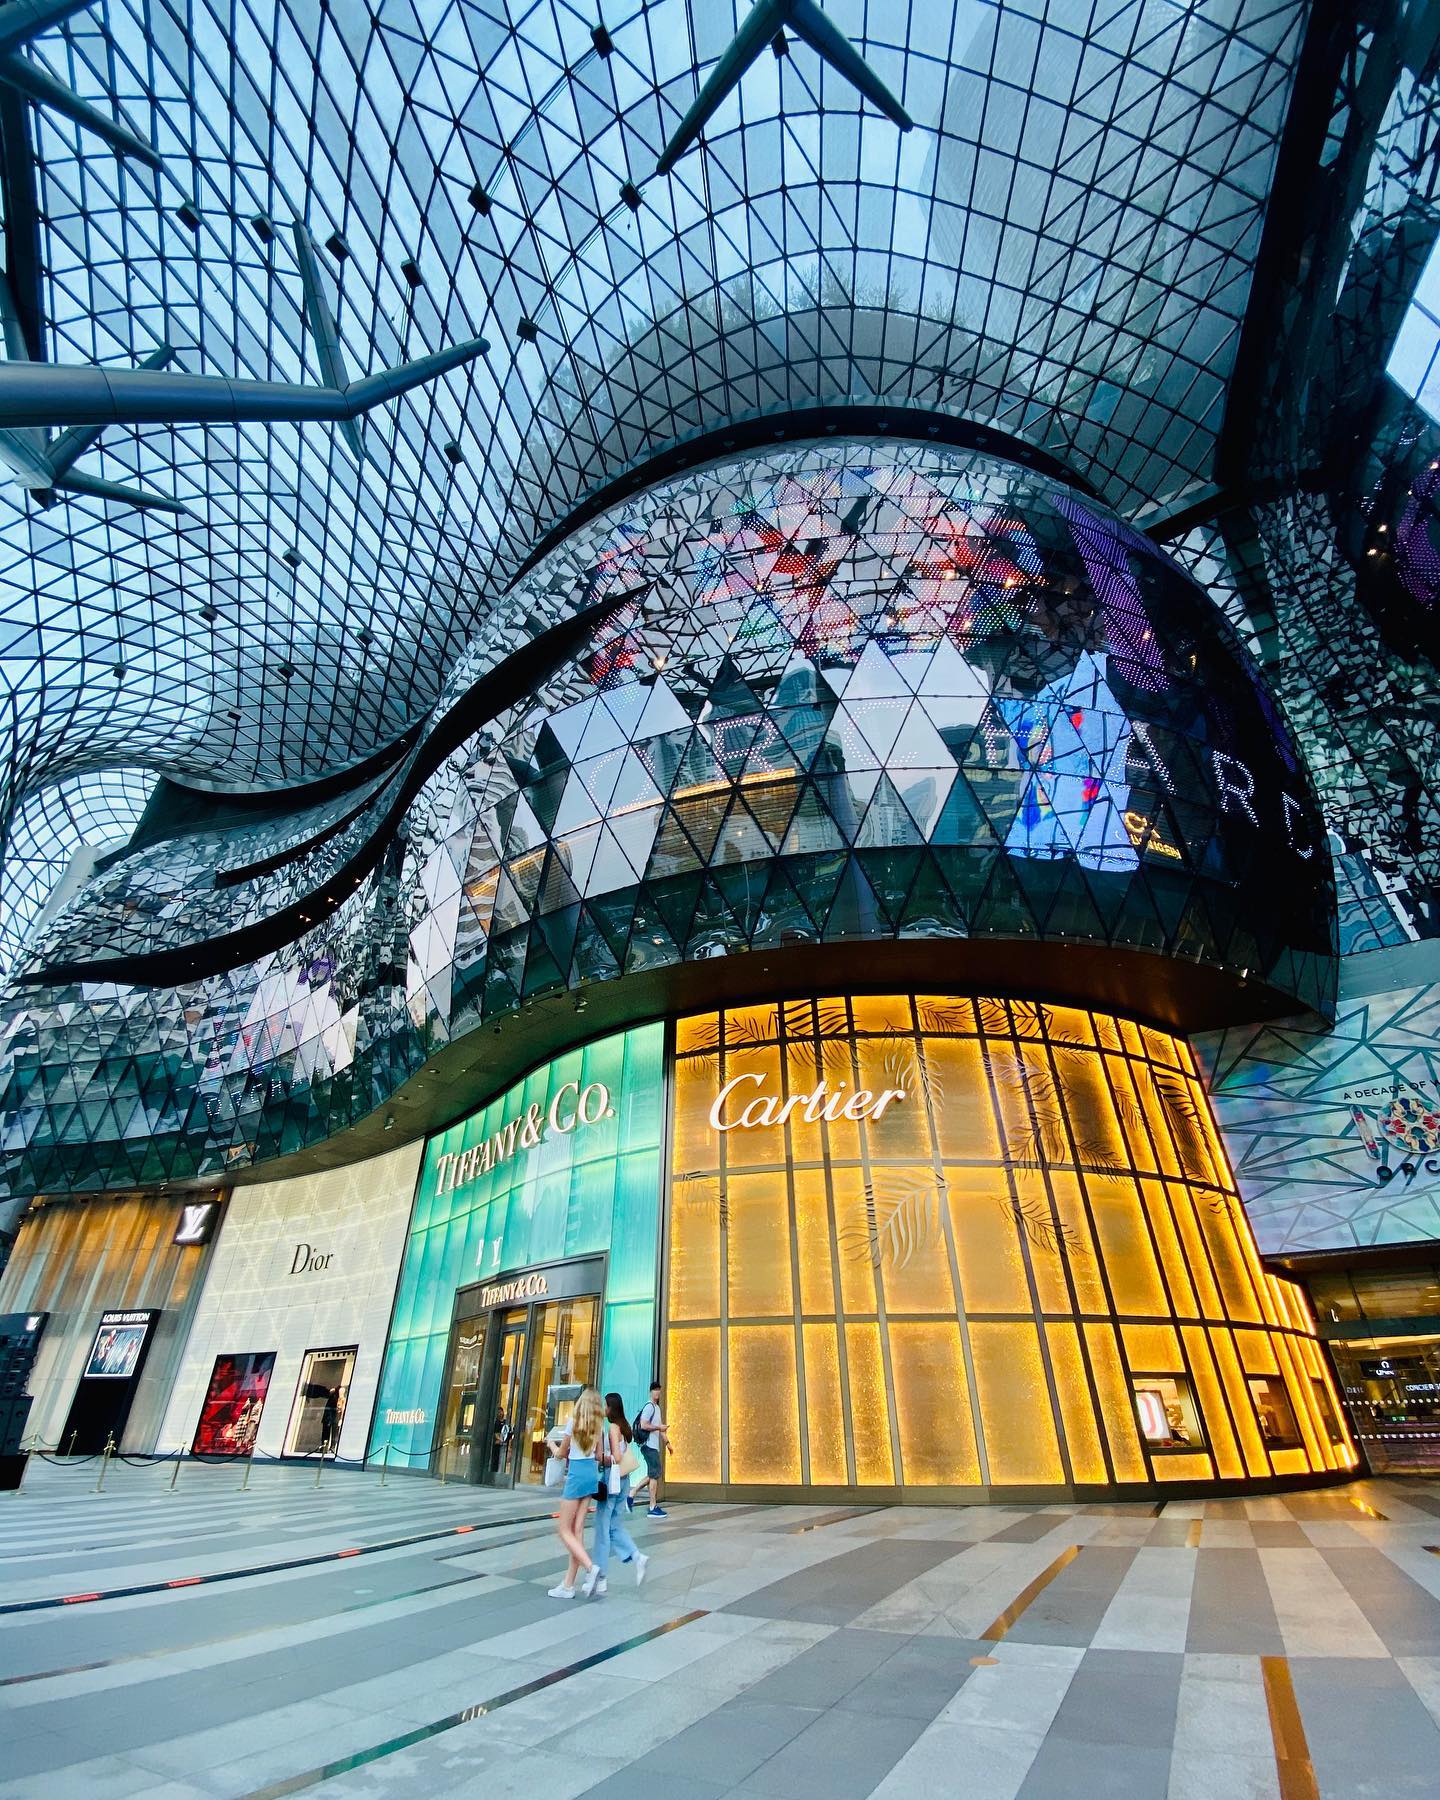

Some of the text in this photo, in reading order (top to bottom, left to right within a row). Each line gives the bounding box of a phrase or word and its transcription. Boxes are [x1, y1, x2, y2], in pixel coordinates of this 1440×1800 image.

[708, 1071, 906, 1131] Cartier
[1354, 1083, 1407, 1099] DECADE
[1410, 1080, 1427, 1091] OF
[288, 1243, 335, 1275] Dior
[102, 1312, 151, 1323] LOUIS VUITTON
